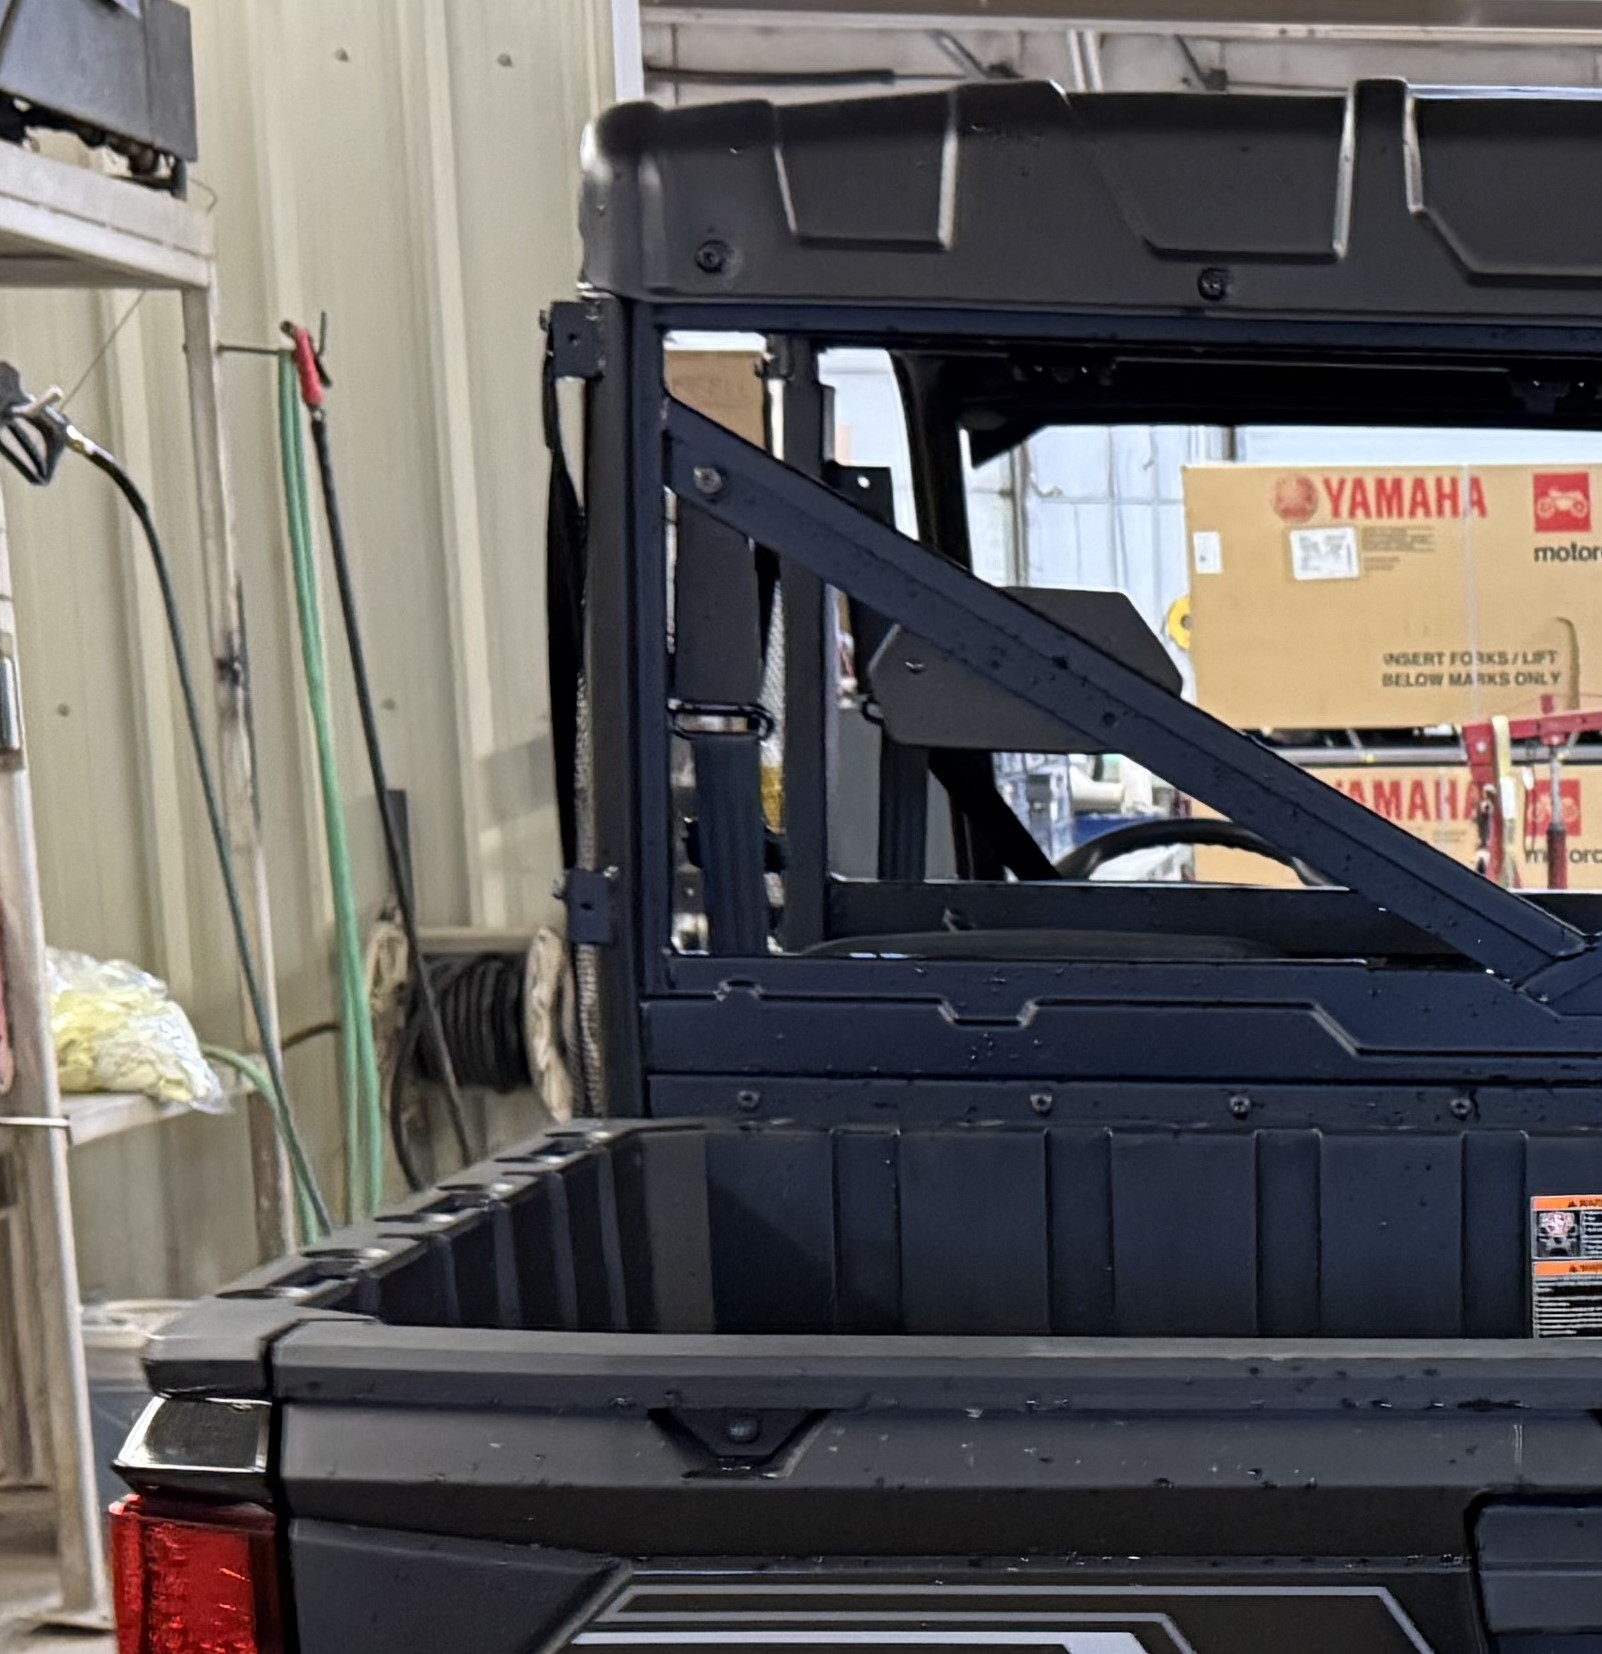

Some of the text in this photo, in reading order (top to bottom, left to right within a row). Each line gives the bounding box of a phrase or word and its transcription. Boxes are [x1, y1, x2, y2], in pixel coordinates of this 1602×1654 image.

[1323, 476, 1488, 520] YAMAHA
[1383, 652, 1445, 666] INSERT
[1450, 651, 1508, 666] FORKS
[1522, 651, 1558, 664] LIFT
[1382, 673, 1443, 687] BELOW
[1514, 671, 1561, 686] ONLY
